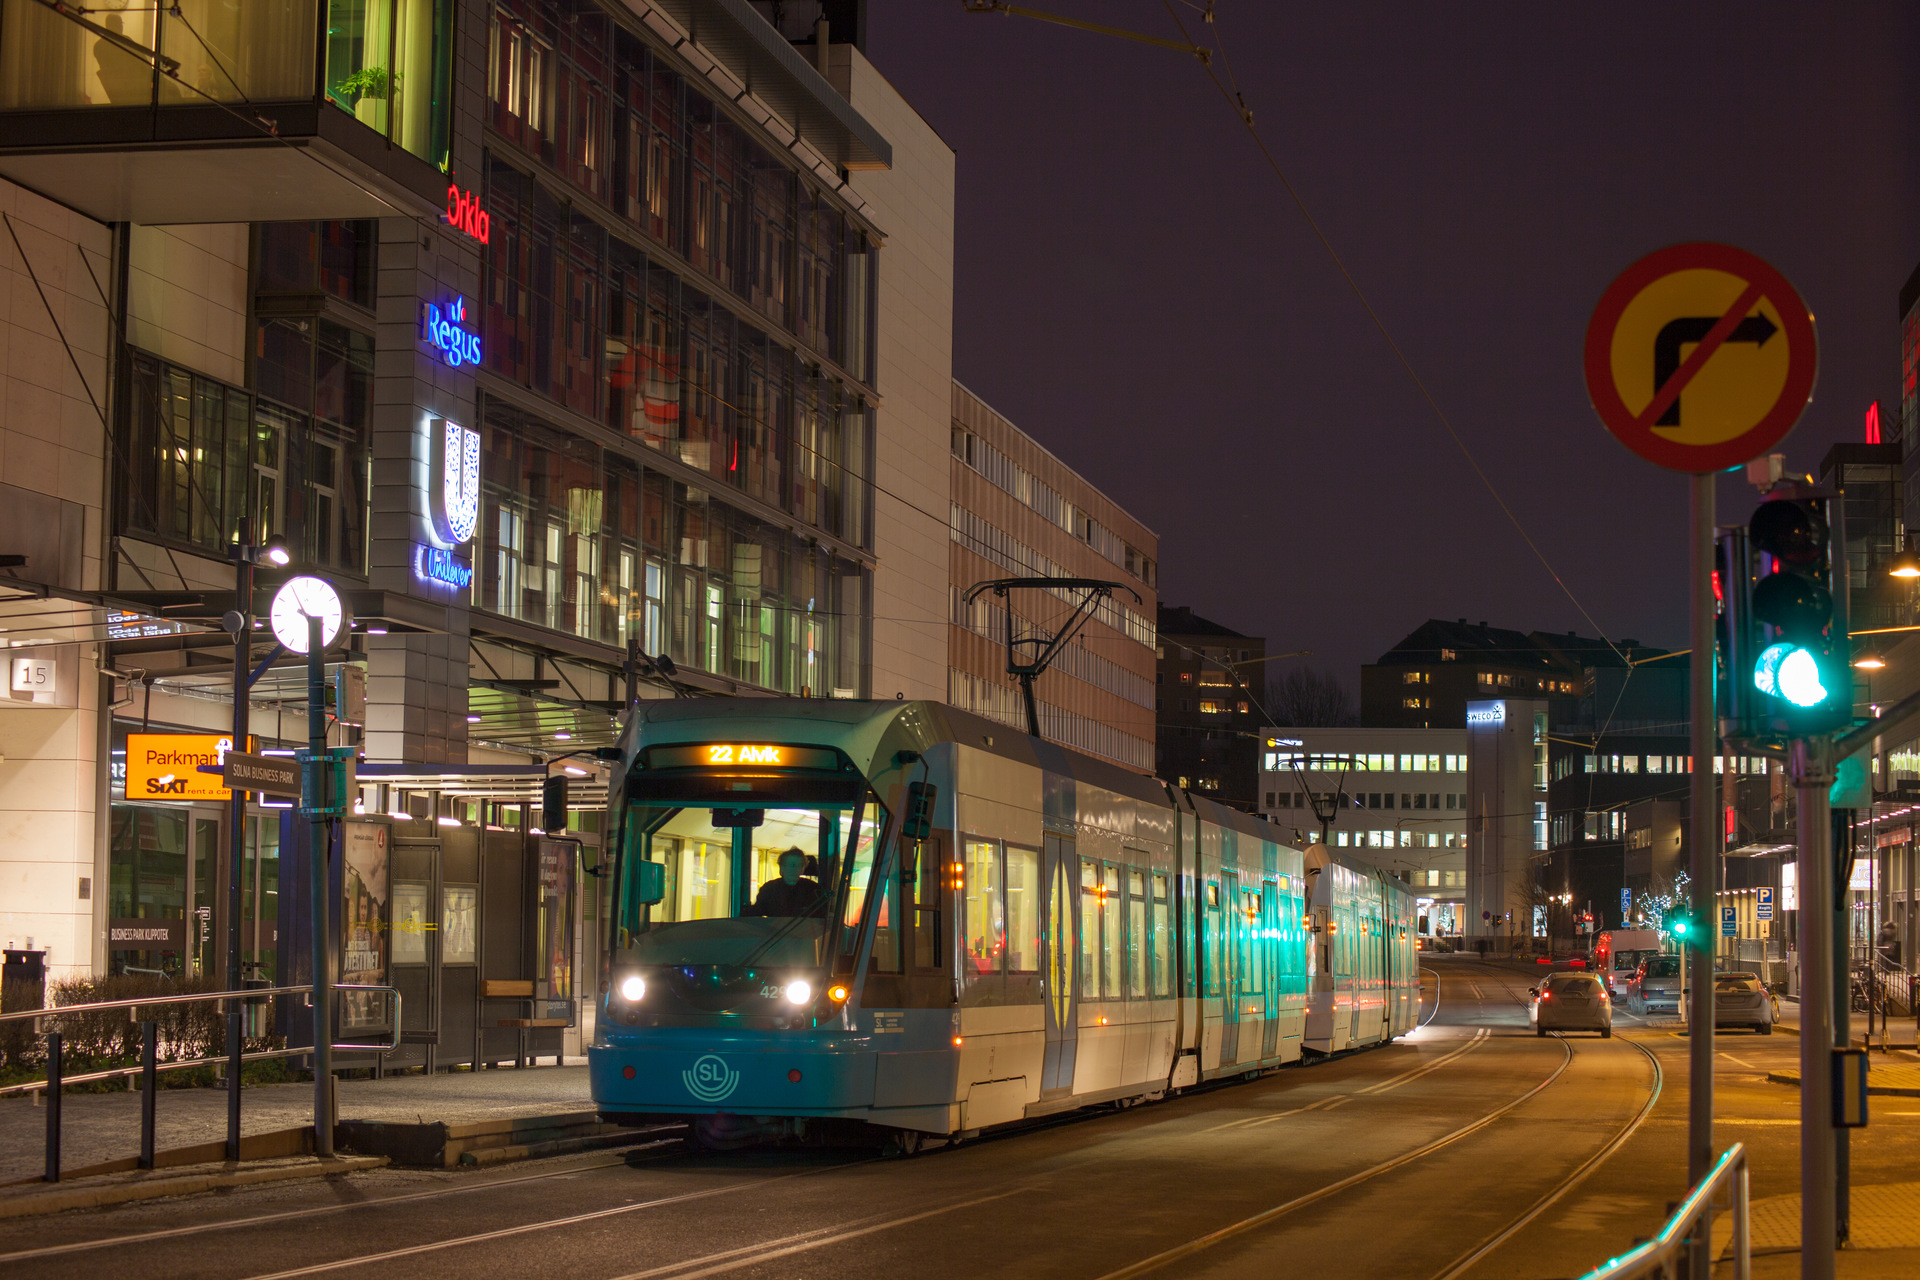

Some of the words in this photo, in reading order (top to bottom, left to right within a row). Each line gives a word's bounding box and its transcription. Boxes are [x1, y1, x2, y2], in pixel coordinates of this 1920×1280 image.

[447, 184, 489, 245] Orkla
[428, 303, 481, 367] Regus
[428, 549, 473, 588] Unilever
[23, 667, 46, 684] 15
[1466, 713, 1492, 721] SWECO
[146, 750, 218, 765] Parkman
[710, 746, 733, 762] 22
[739, 746, 780, 762] Alvik
[233, 763, 251, 778] SOLNA
[252, 767, 279, 782] BUSINESS
[280, 771, 294, 784] PARK
[1760, 889, 1770, 903] P
[1724, 908, 1734, 921] P
[111, 928, 133, 941] BUSINESS
[133, 928, 145, 941] PARK
[699, 1063, 723, 1081] SL
